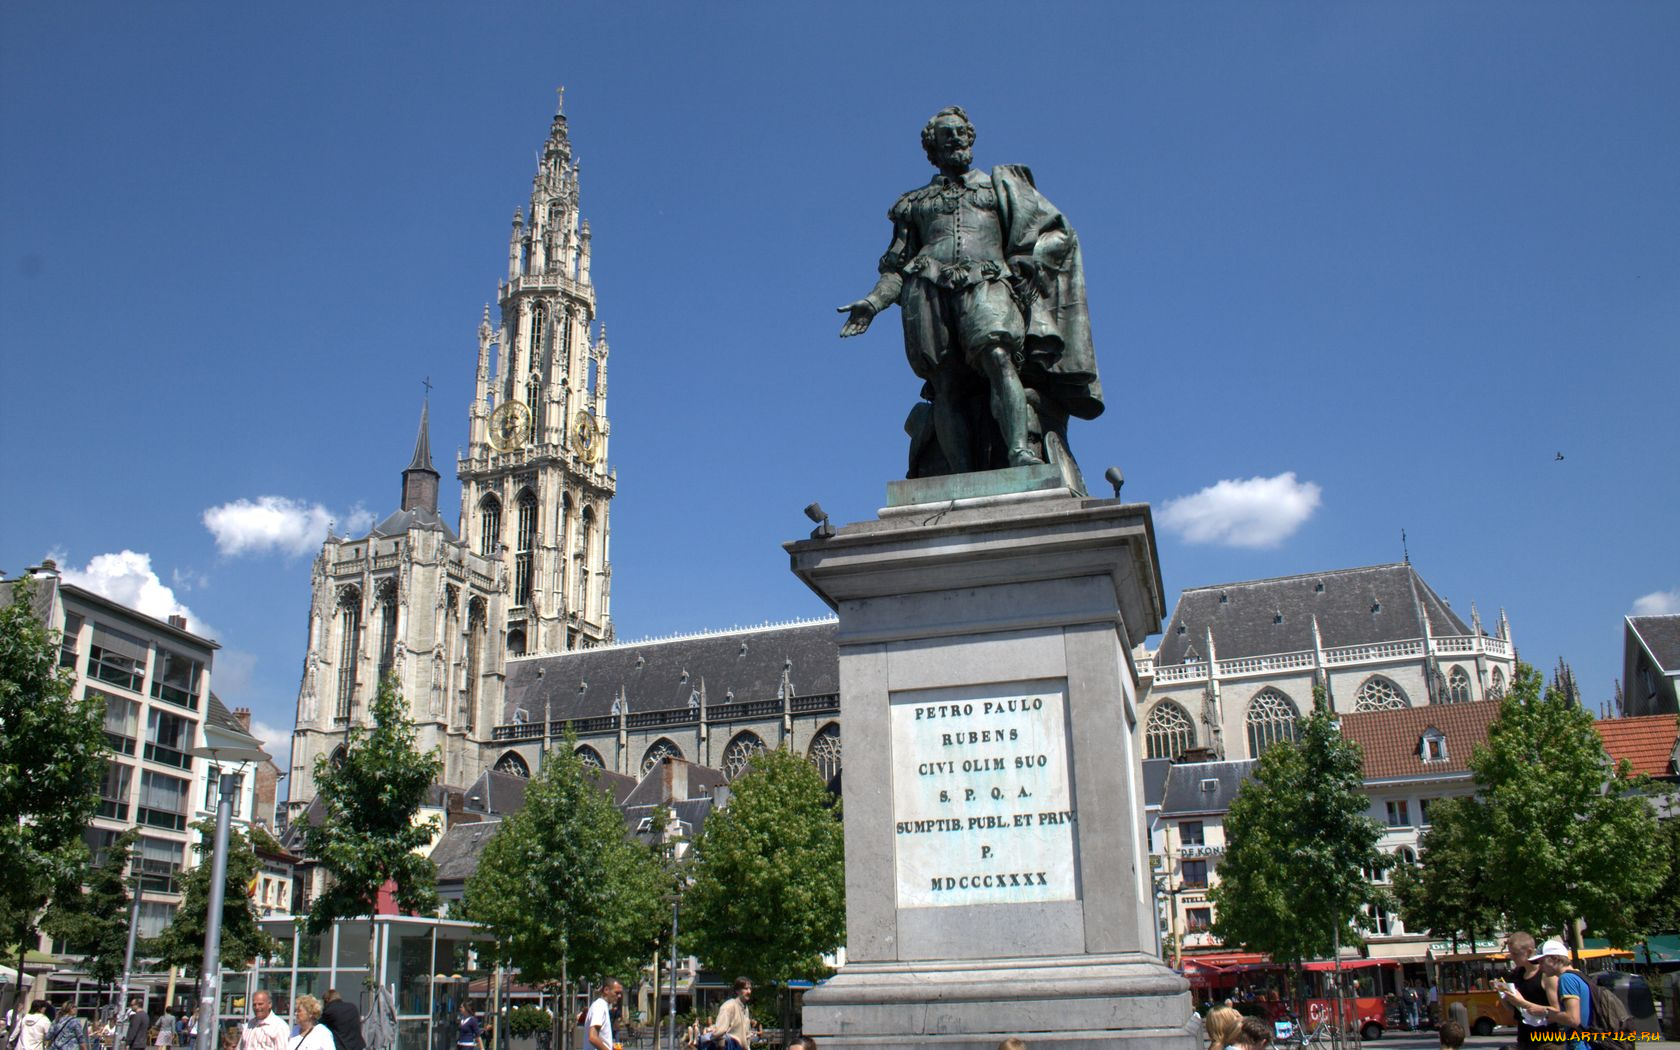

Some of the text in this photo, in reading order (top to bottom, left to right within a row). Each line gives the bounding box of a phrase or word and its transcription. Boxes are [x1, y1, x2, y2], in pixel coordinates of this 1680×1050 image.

[915, 698, 1043, 720] PETRO PAULO
[942, 728, 1018, 746] RUBENS
[918, 754, 1047, 776] CIVI OLIM SUO
[896, 818, 964, 834] SUMPTIB.
[1013, 814, 1033, 828] ET
[1038, 810, 1077, 826] PRIV.
[931, 872, 1048, 891] MDCCCXXXX
